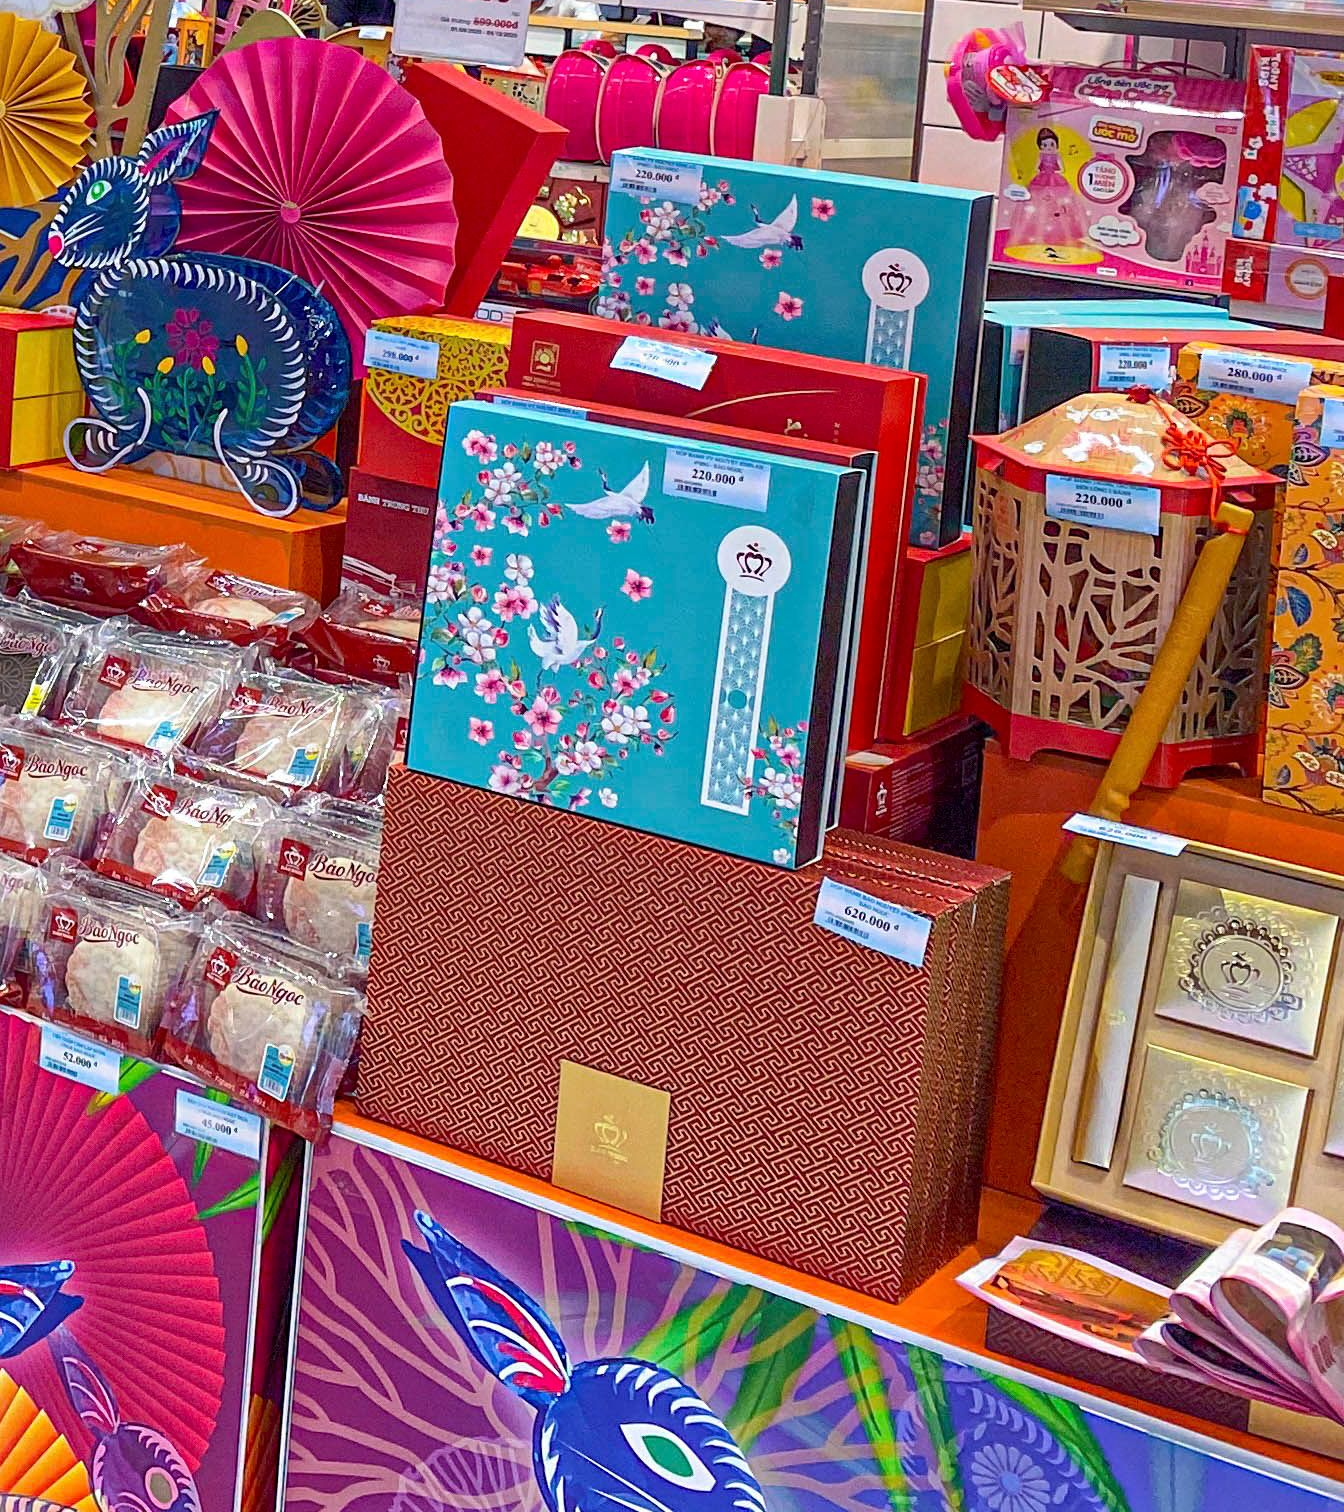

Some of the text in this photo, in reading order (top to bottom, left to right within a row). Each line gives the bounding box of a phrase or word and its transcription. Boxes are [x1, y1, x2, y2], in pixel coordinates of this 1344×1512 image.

[635, 169, 673, 182] 220.000
[1088, 172, 1095, 187] 1
[1227, 367, 1274, 383] 280.000
[692, 468, 736, 486] 220.000
[1074, 492, 1123, 509] 220.000
[844, 906, 891, 933] 620.000
[62, 1050, 93, 1070] 52.000
[201, 1118, 232, 1136] 45.000
